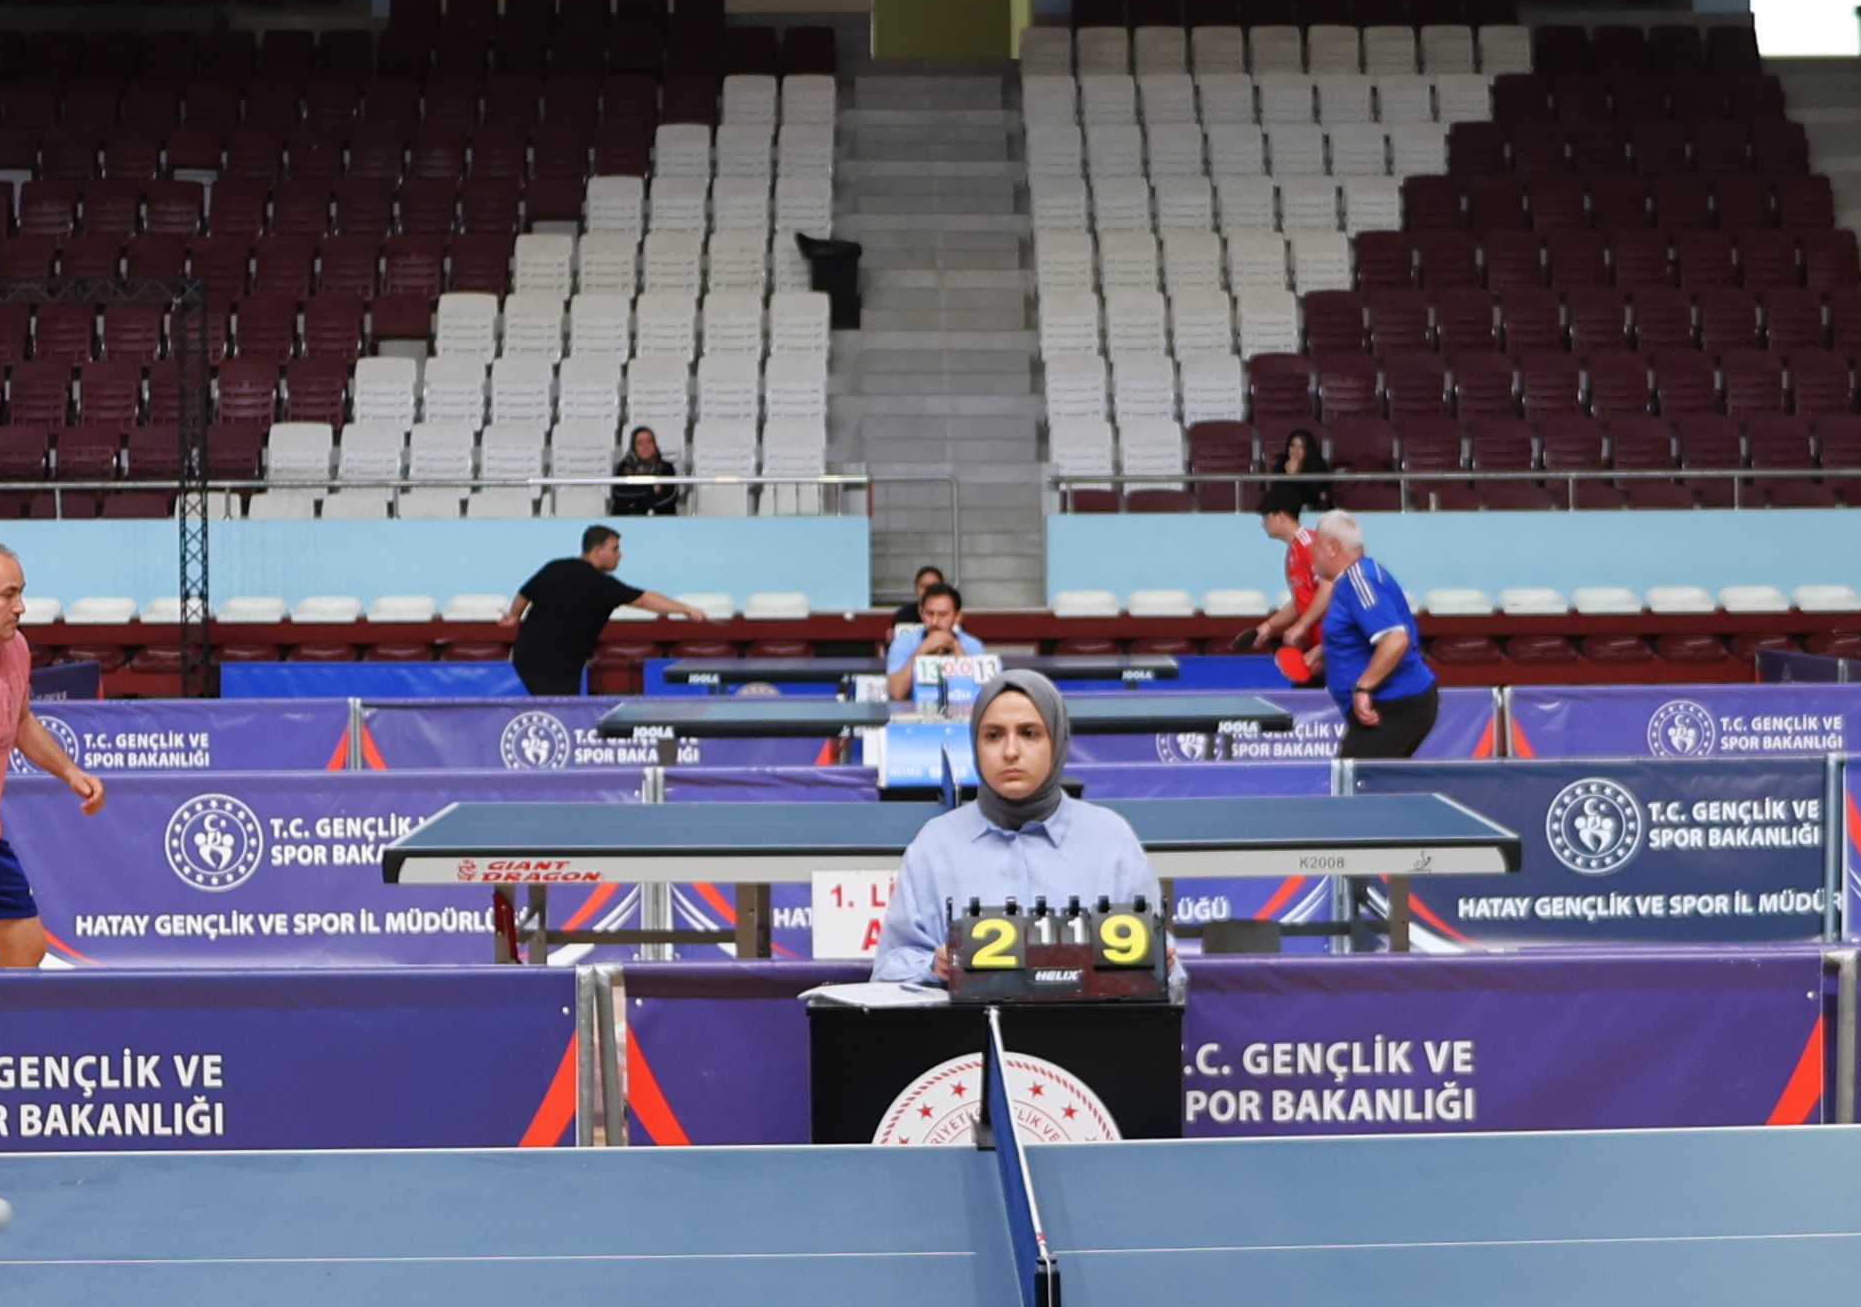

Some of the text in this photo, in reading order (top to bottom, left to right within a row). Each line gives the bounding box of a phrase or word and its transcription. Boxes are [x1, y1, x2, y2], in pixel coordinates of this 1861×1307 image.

[633, 725, 674, 739] JOOLA
[1218, 720, 1260, 734] JOOLA
[1751, 713, 1843, 736] GENÇLİK VE
[83, 729, 209, 752] T.C. GENÇLİK VE
[1719, 733, 1843, 751] SPOR BAKANLIĞI
[83, 748, 210, 767] SPOR BAKANLIĞI
[574, 747, 615, 764] SPOR
[1648, 796, 1821, 826] T.C. GENÇLİK VE
[270, 812, 412, 843] T.C. GENÇLİK
[1648, 822, 1821, 848] SPOR BAKANLIĞI
[270, 844, 327, 867] SPOR
[487, 860, 571, 871] GIANT
[1299, 855, 1345, 870] K2008
[480, 872, 602, 882] DRAGON
[830, 883, 855, 908] 1.
[1458, 890, 1754, 922] HATAY GENÇLİK VE SPOR İL
[75, 908, 380, 942] HATAY GENÇLİK VE SPOR İL
[971, 914, 1149, 968] 2 1 1 9
[1034, 969, 1080, 981] HELIX
[1242, 1034, 1474, 1083] GENÇLİK VE
[172, 1053, 224, 1089] VE
[1271, 1081, 1475, 1122] BAKANLIĞI
[19, 1094, 225, 1137] BAKANLIĞI
